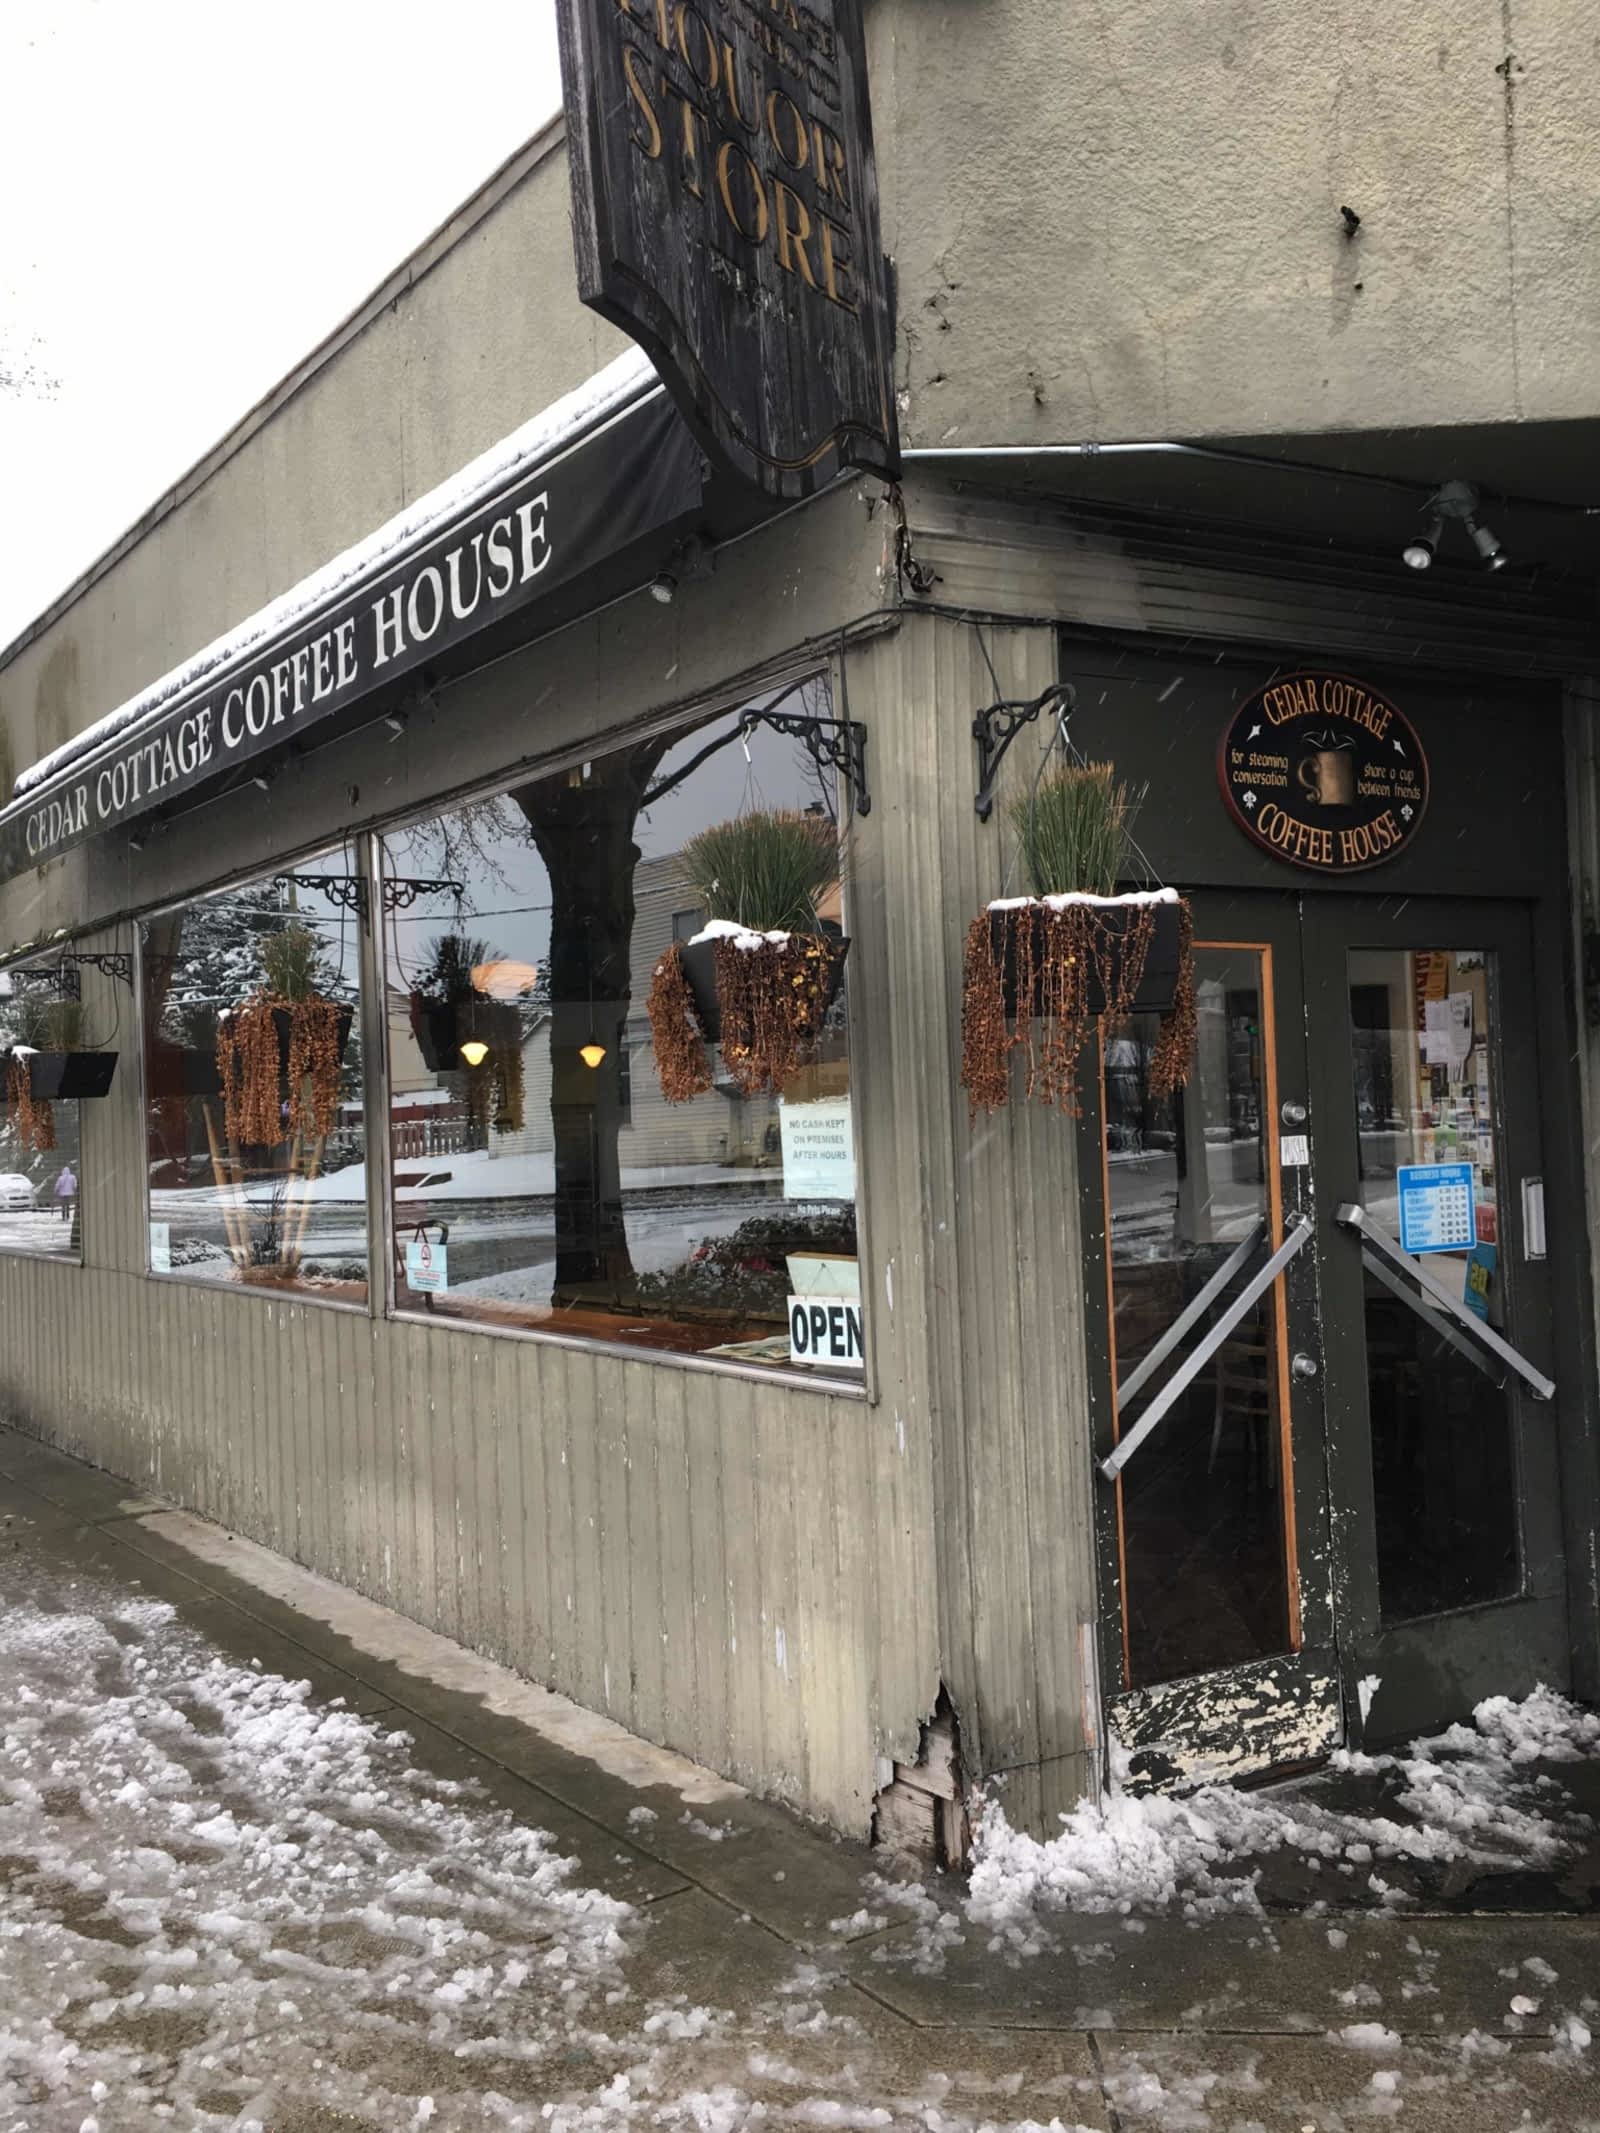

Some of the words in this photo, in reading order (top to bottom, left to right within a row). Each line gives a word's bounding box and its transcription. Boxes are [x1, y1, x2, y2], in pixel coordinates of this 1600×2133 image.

[615, 0, 852, 213] IQUOR
[622, 38, 861, 318] STORE
[25, 785, 88, 857] CEDAR
[97, 709, 213, 819] COTTAGE
[221, 617, 357, 749] COFFEE
[373, 492, 553, 669] HOUSE
[1263, 679, 1320, 726] CEDAR
[1323, 679, 1393, 741] COTTAGE
[1231, 749, 1244, 765] for
[1249, 751, 1289, 773] steaming
[1363, 762, 1386, 779] share
[1389, 769, 1396, 780] a
[1399, 768, 1415, 782] cup
[1232, 769, 1288, 787] conversation
[1357, 779, 1391, 798] between
[1394, 782, 1422, 801] friends
[1257, 803, 1333, 864] COFFEE
[1339, 809, 1403, 864] HOUSE
[789, 1119, 800, 1129] NO
[802, 1119, 825, 1129] CASH
[825, 1119, 846, 1129] KEPT
[793, 1135, 806, 1145] ON
[806, 1135, 845, 1145] PREMISES
[793, 1150, 818, 1160] AFTER
[820, 1150, 848, 1161] HOURS
[791, 1303, 864, 1357] OPEN
